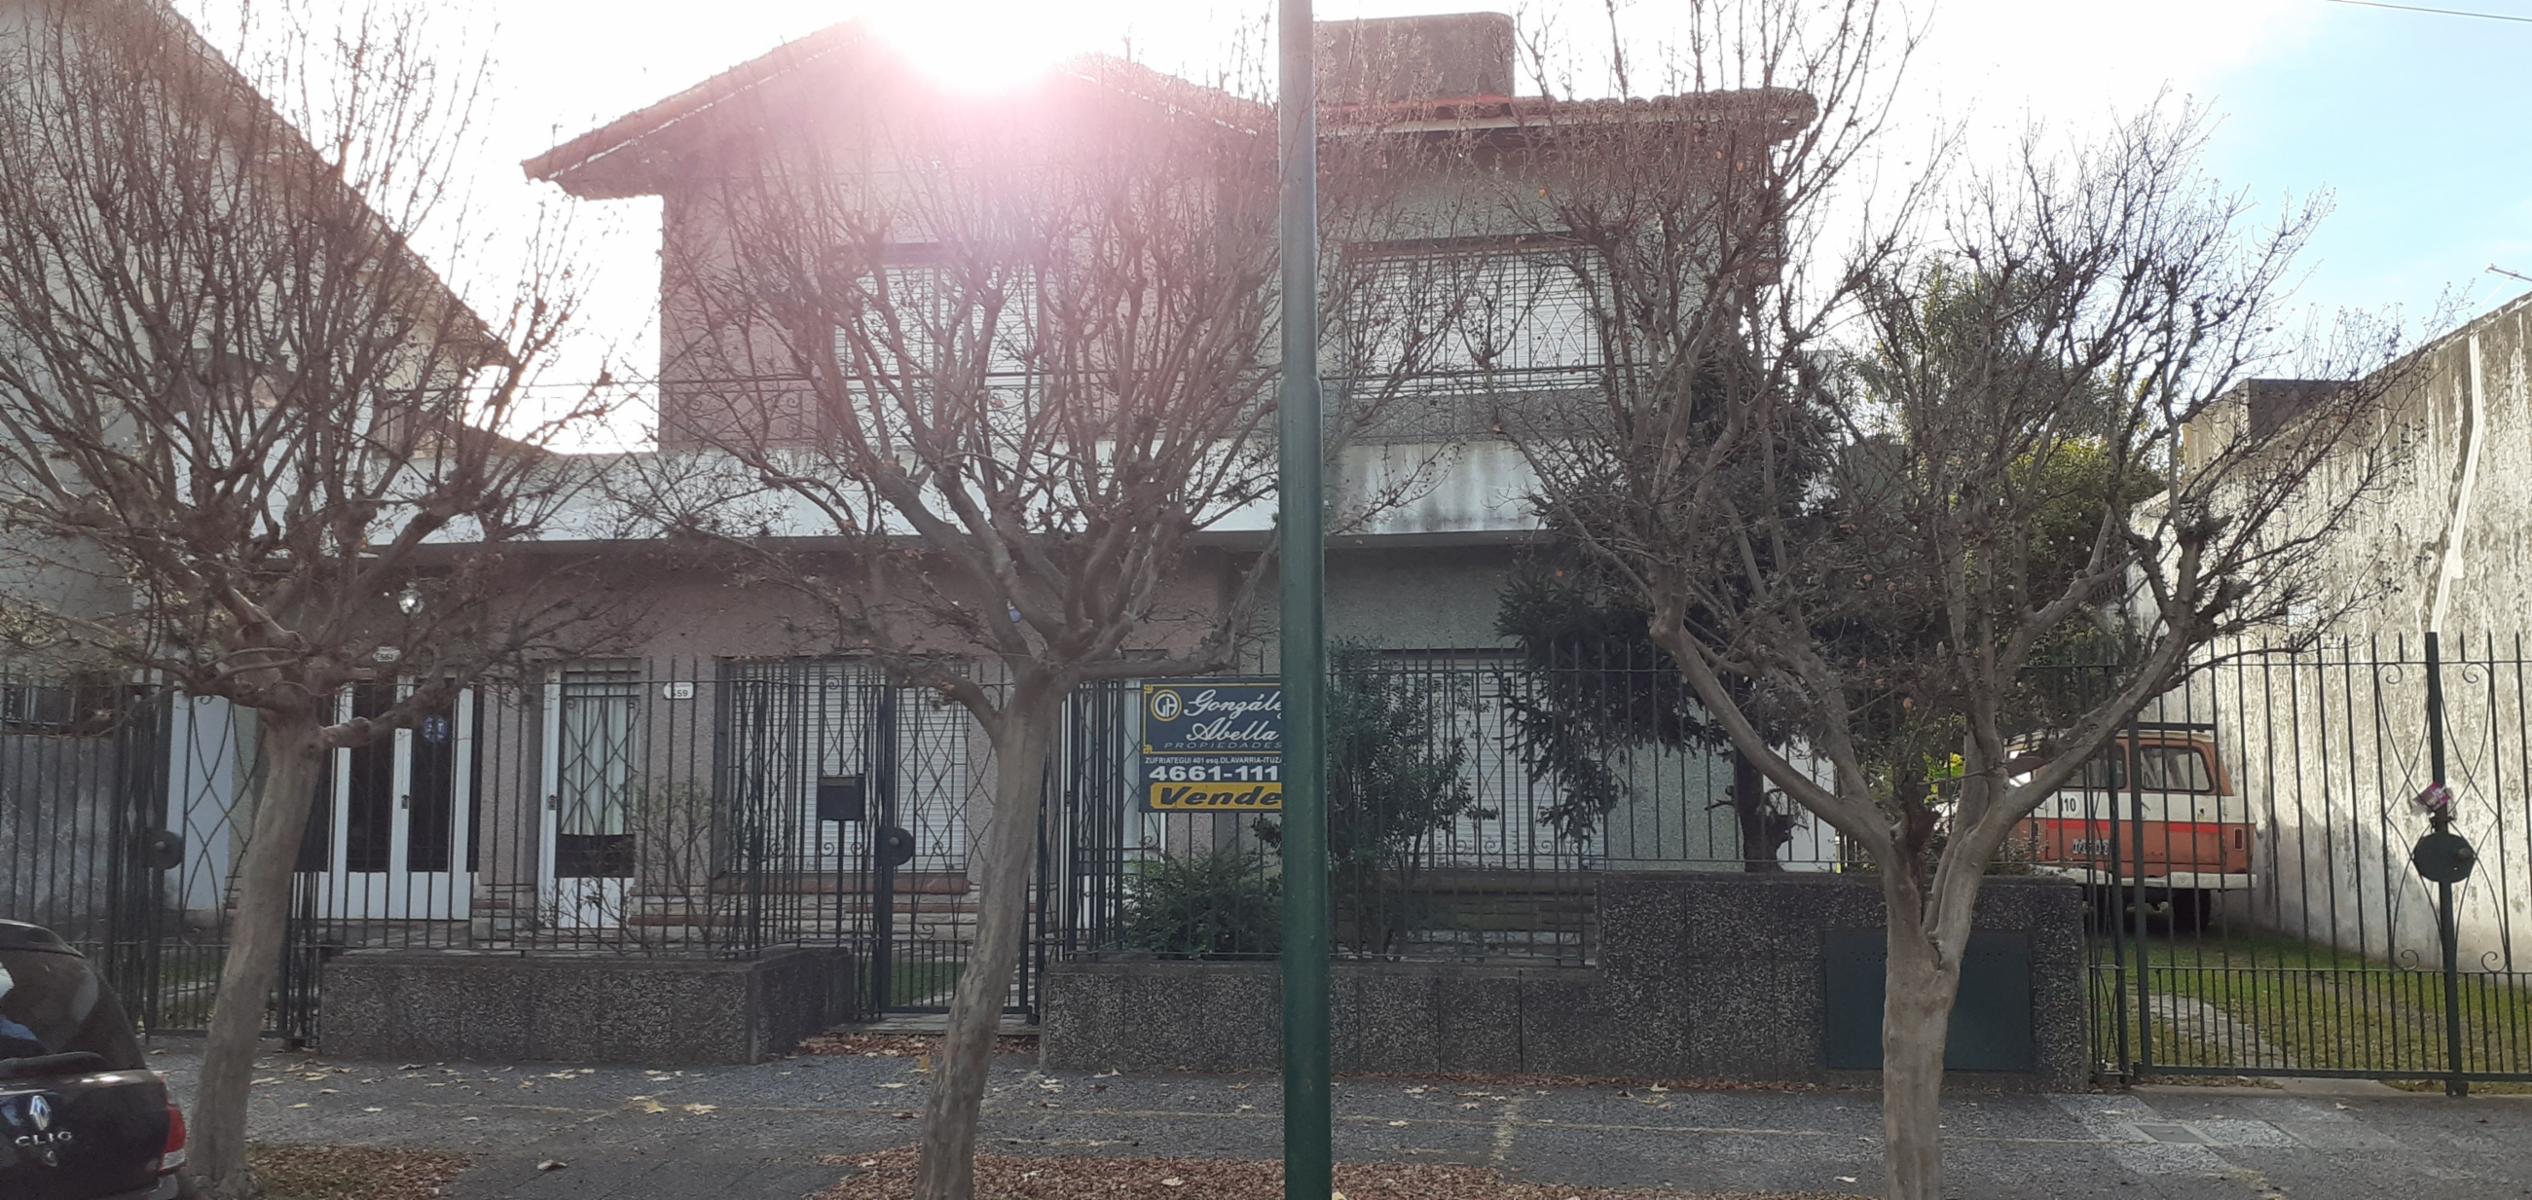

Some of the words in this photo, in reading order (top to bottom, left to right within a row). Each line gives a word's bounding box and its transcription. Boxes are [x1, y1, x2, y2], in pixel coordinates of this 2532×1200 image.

[1183, 689, 1282, 720] Gonzále
[1186, 717, 1280, 742] Abella
[1160, 785, 1282, 806] Vende
[15, 1131, 72, 1147] CLIO
